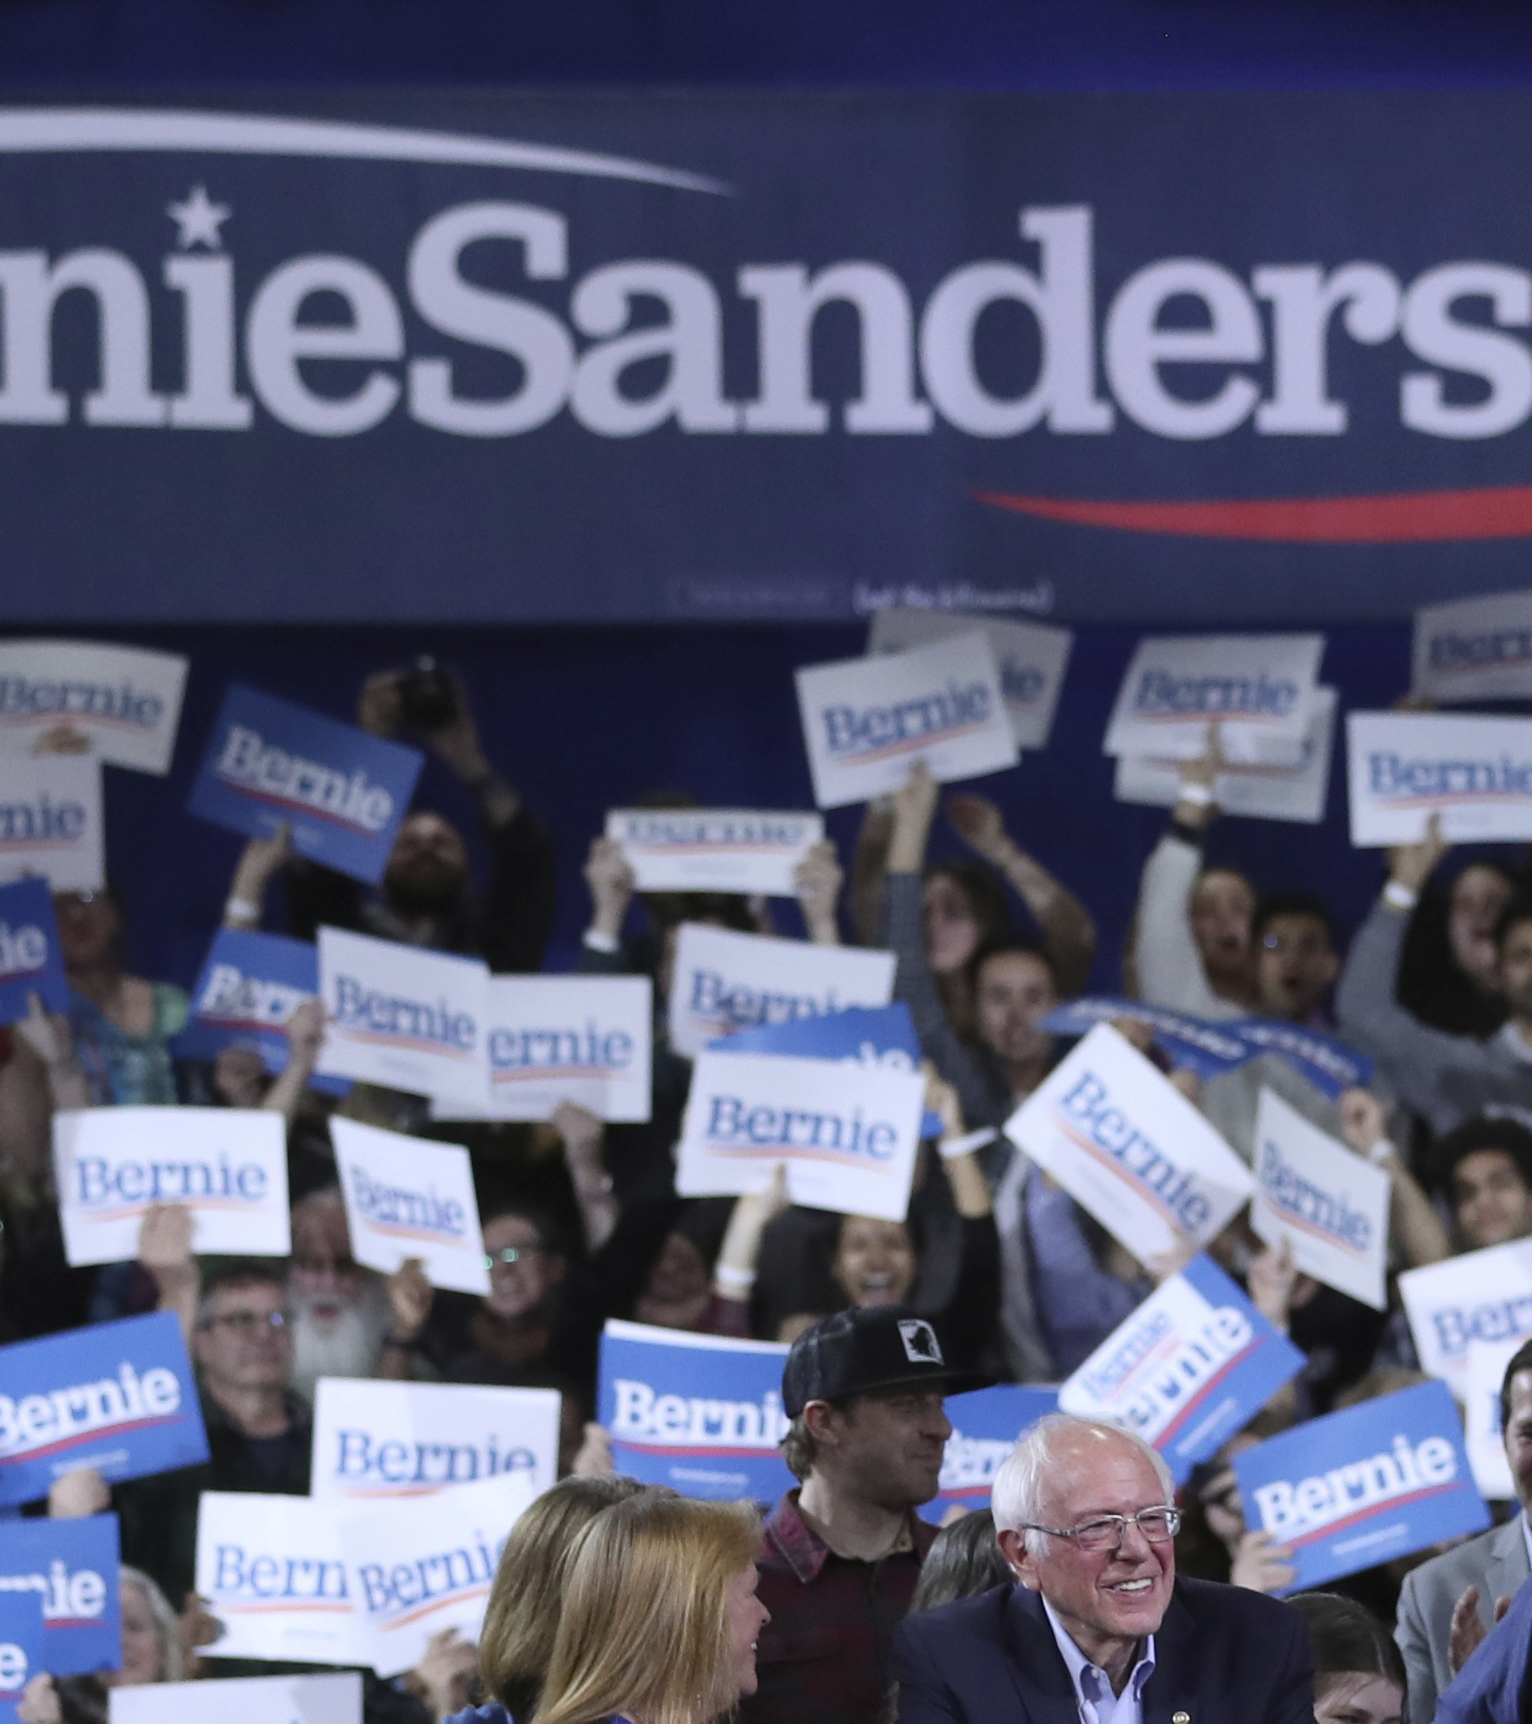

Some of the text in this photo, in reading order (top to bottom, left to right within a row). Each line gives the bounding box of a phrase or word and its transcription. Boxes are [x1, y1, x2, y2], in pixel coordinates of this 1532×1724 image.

[824, 679, 990, 751] Bernie
[1139, 669, 1298, 717] Bernie
[222, 726, 394, 831] Bernie
[335, 975, 476, 1050] Bernie
[487, 1020, 633, 1069] ernie
[706, 1096, 899, 1160] Bernie
[1062, 1071, 1214, 1235] Bernie
[76, 1152, 266, 1202] Bernie
[350, 1164, 466, 1238] Bernie
[614, 1378, 794, 1447] Berni
[335, 1429, 537, 1480] Bernie
[1256, 1433, 1457, 1531] Bernie
[215, 1540, 349, 1597] Bern
[361, 1521, 496, 1609] Berni
